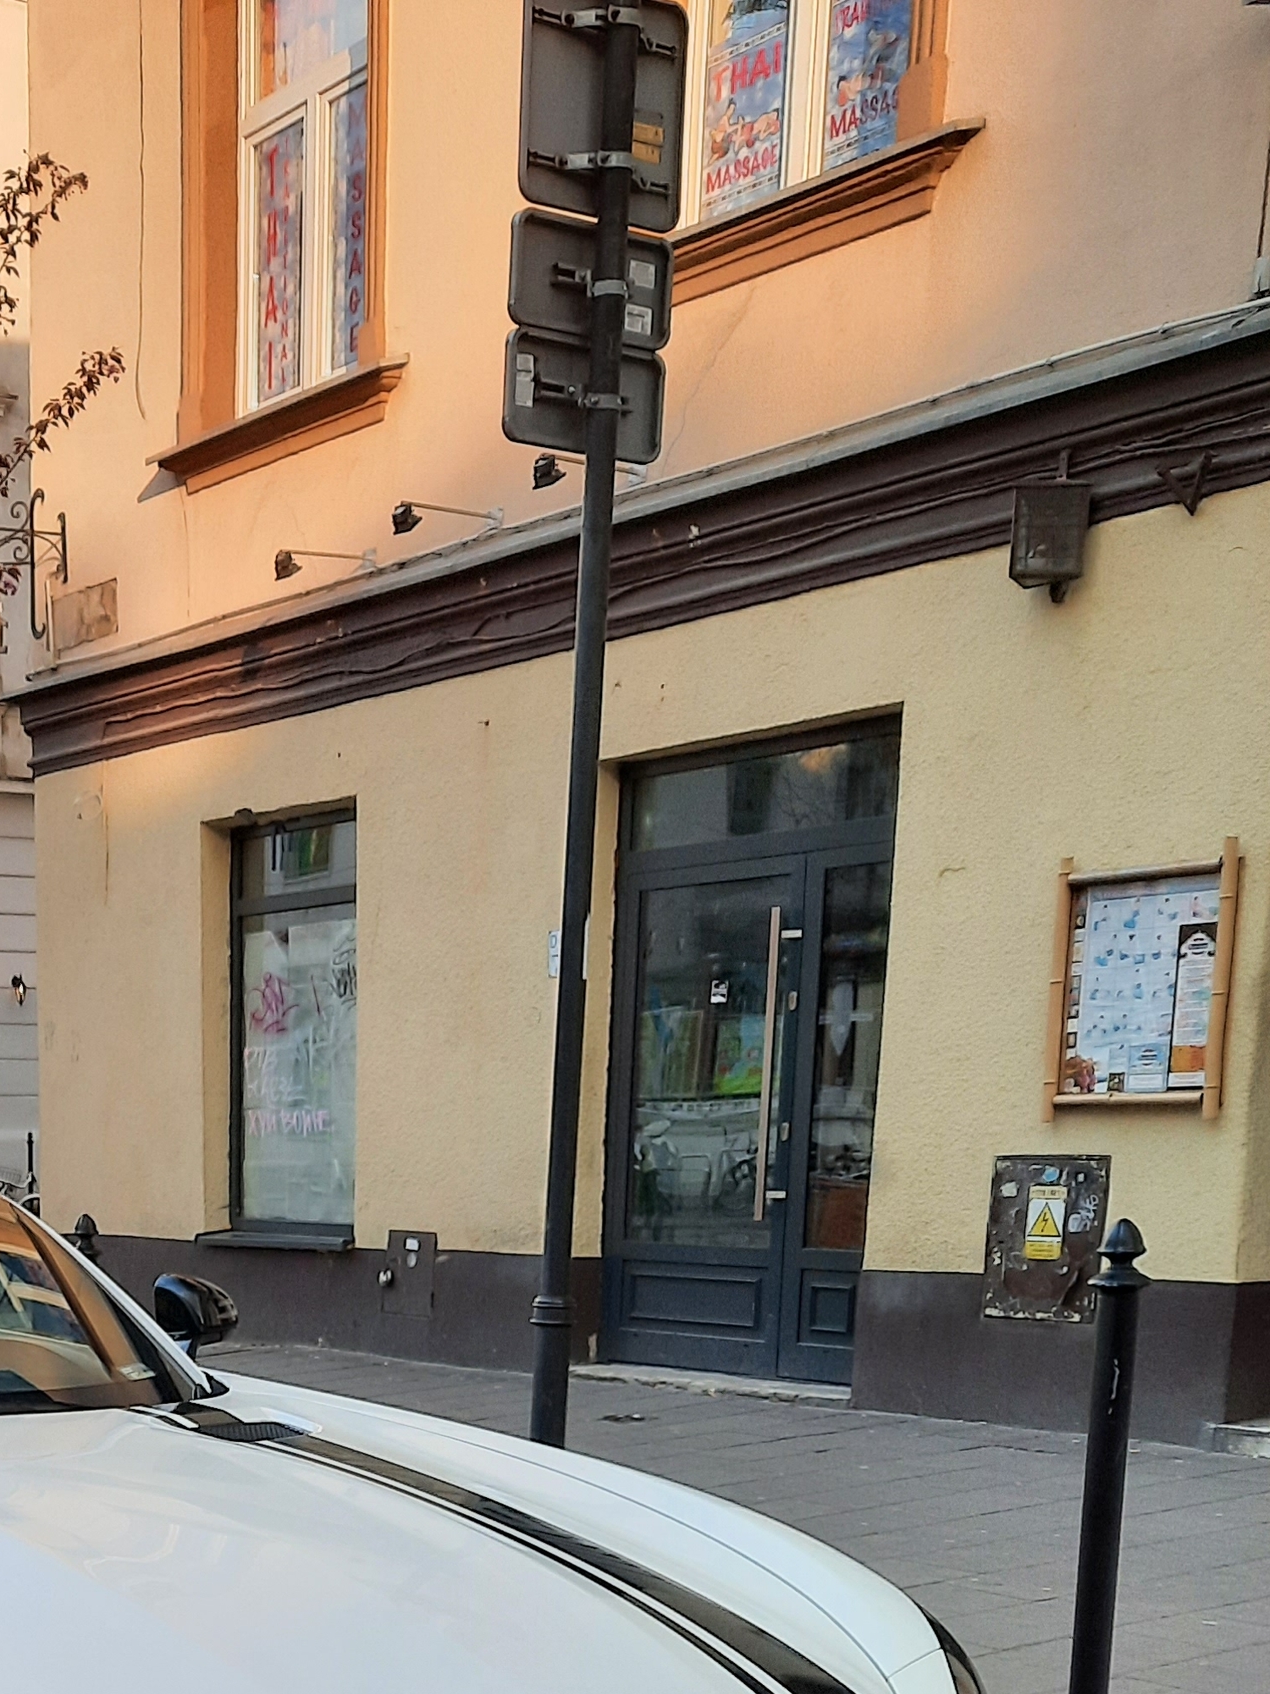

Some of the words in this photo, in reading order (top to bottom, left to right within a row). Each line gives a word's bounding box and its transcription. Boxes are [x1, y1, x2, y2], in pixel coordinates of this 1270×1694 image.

[713, 40, 783, 103] THAI
[705, 142, 779, 195] MASSAGE
[265, 143, 279, 390] THAI
